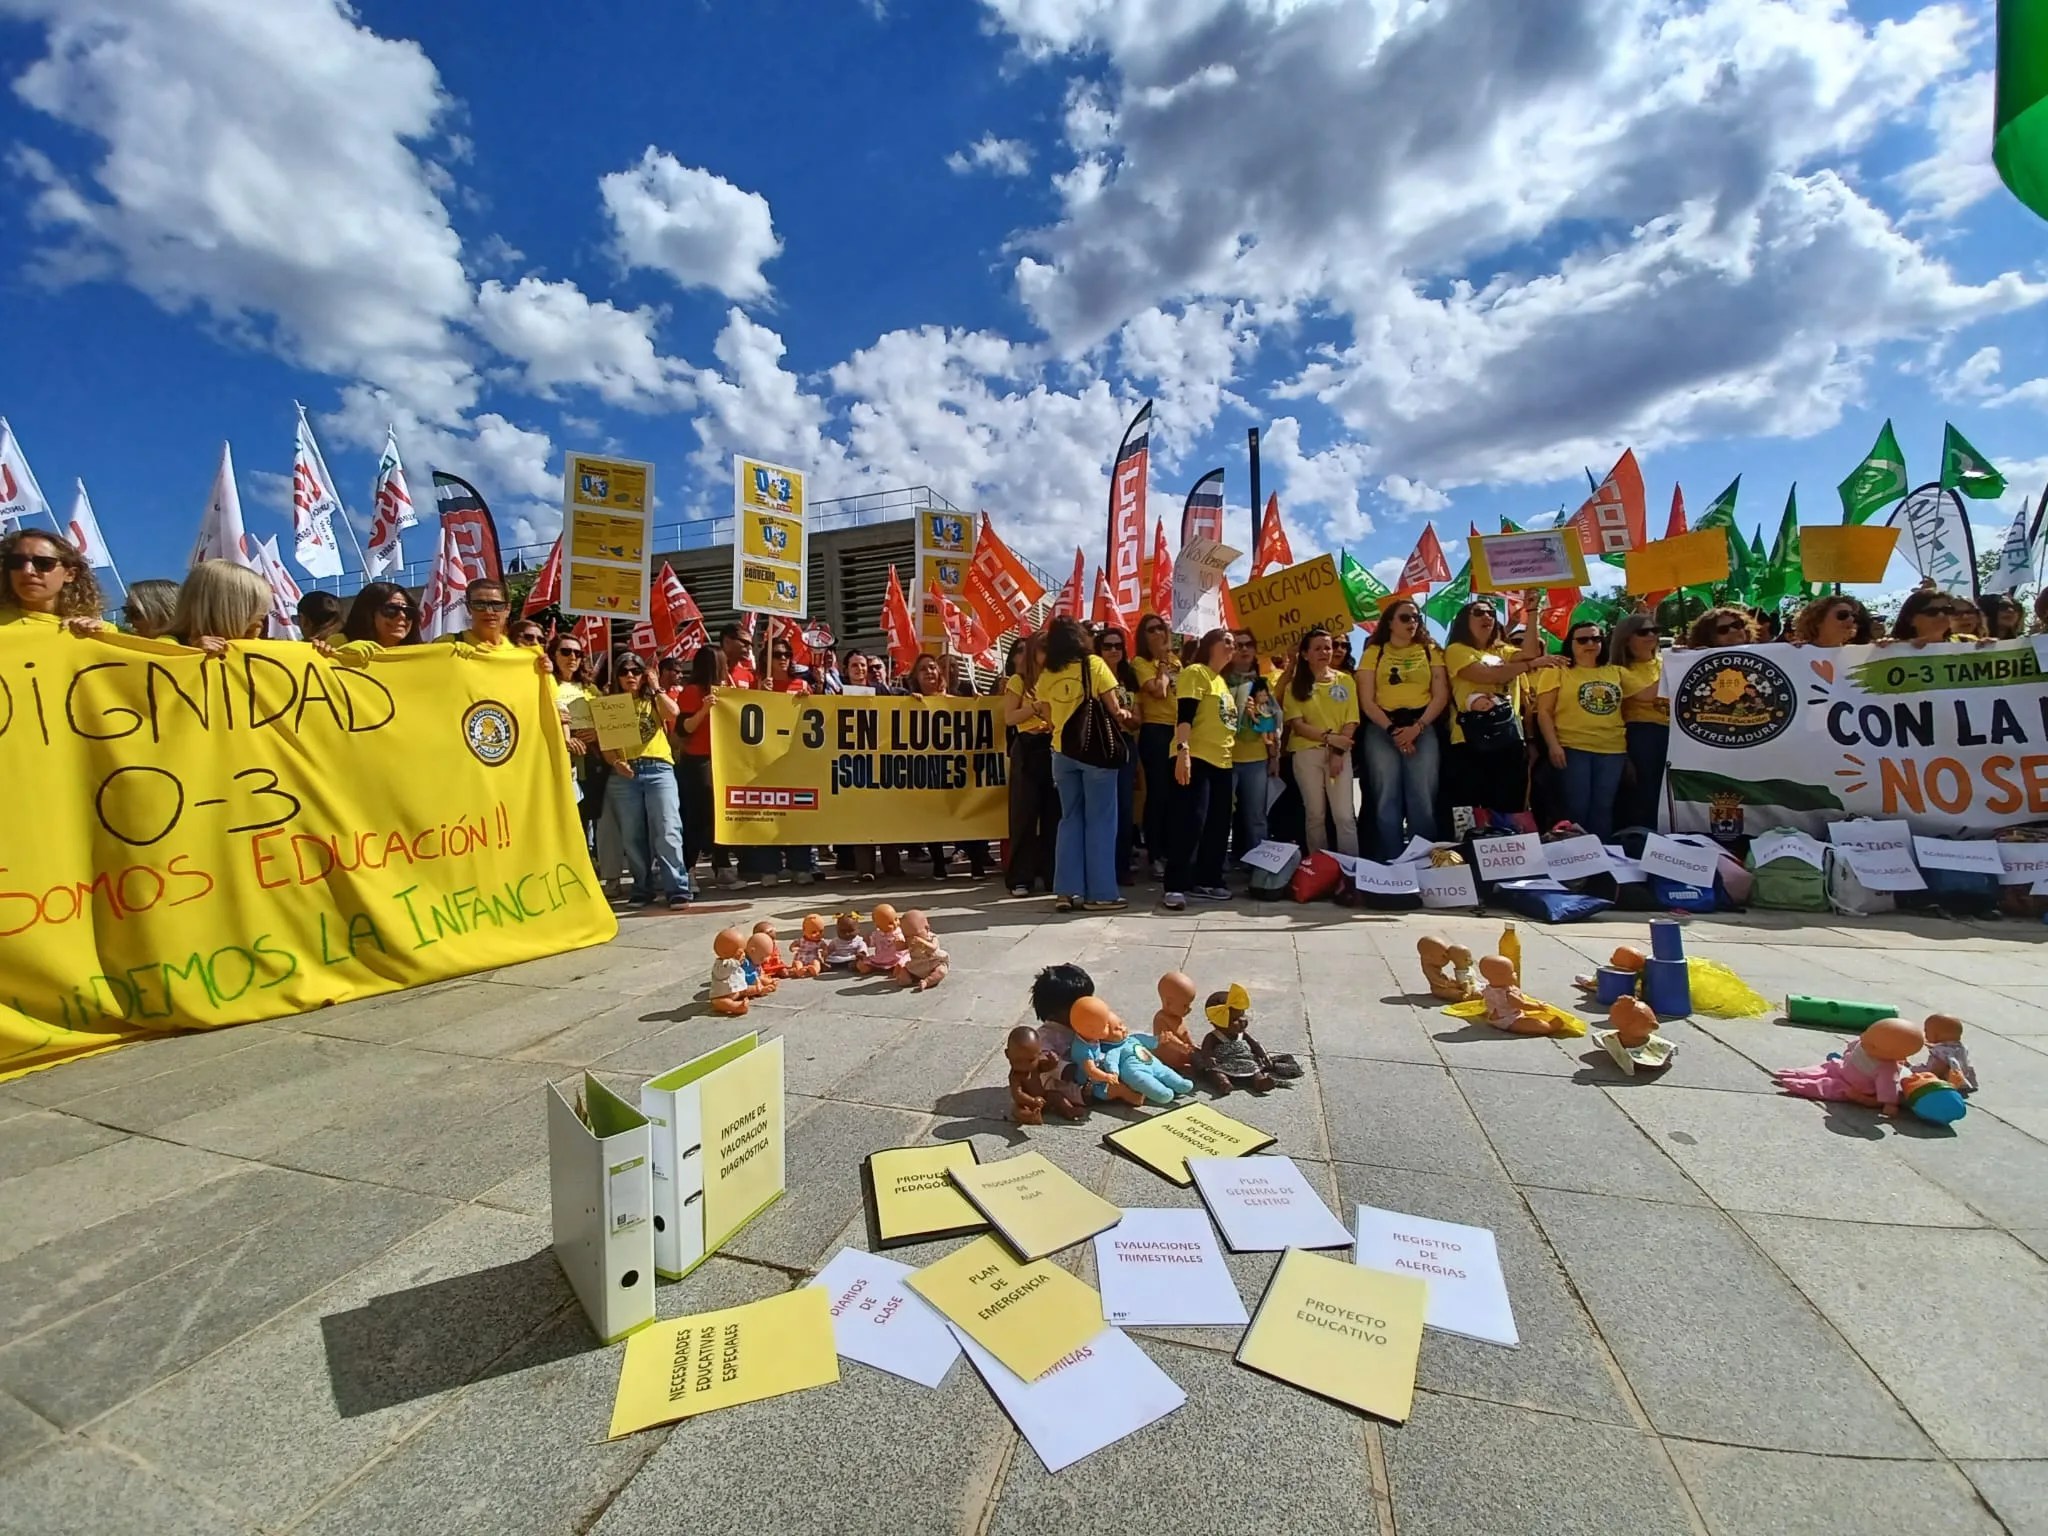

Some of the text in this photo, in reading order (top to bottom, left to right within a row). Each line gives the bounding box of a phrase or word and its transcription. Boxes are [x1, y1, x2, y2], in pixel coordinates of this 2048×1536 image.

[1117, 466, 1140, 614] CCOO
[1239, 562, 1336, 615] EDUCAMOS
[1279, 608, 1300, 628] NO
[1685, 656, 1763, 690] PLATAFORMA
[1887, 653, 2040, 687] 0-3 TAMBIÉ
[837, 709, 878, 750] EN
[891, 709, 993, 750] LUCHA
[1689, 722, 1779, 743] EXTREMADURA
[1827, 700, 1935, 747] CON
[1954, 698, 2029, 746] LA
[831, 751, 1006, 795] ¡SOLUCIONES YA!
[1878, 755, 1974, 814] NO
[730, 791, 790, 805] CCOO
[1479, 842, 1526, 854] CALEN
[1482, 855, 1526, 868] DARIO
[1651, 850, 1709, 873] RECURSOS
[1360, 874, 1413, 887] SALARIO
[320, 912, 386, 966] LA
[393, 863, 591, 950] INFANCIA
[721, 1102, 767, 1141] INFORME DE
[1186, 1114, 1241, 1145] EXPEDIENTES
[1186, 1126, 1217, 1144] DE LOS
[1161, 1123, 1220, 1157] ALUMNOS/AS
[720, 1136, 769, 1180] DIAGNÓSTICA
[1020, 1190, 1043, 1201] AULA
[1226, 1187, 1295, 1197] GENERAL DE
[1239, 1177, 1269, 1185] PLAN
[1243, 1197, 1291, 1207] CENTRO
[1114, 1241, 1201, 1251] EVALUACIONES
[1392, 1232, 1463, 1252] REGISTRO
[1419, 1250, 1439, 1260] DE
[1117, 1253, 1204, 1264] TRIMESTRALES
[1395, 1258, 1468, 1279] ALERGIAS
[968, 1263, 1001, 1285] PLAN
[990, 1277, 1009, 1292] DE
[830, 1277, 869, 1317] DIARIOS
[859, 1296, 878, 1312] DE
[873, 1295, 903, 1325] CLASE
[978, 1273, 1051, 1321] EMERGENCIA
[1296, 1310, 1388, 1346] EDUCATIVO
[1305, 1296, 1387, 1330] PROYECTO
[669, 1328, 692, 1402] NECESIDADES
[696, 1325, 716, 1393] EDUCATIVAS
[722, 1323, 740, 1382] ESPECIALES
